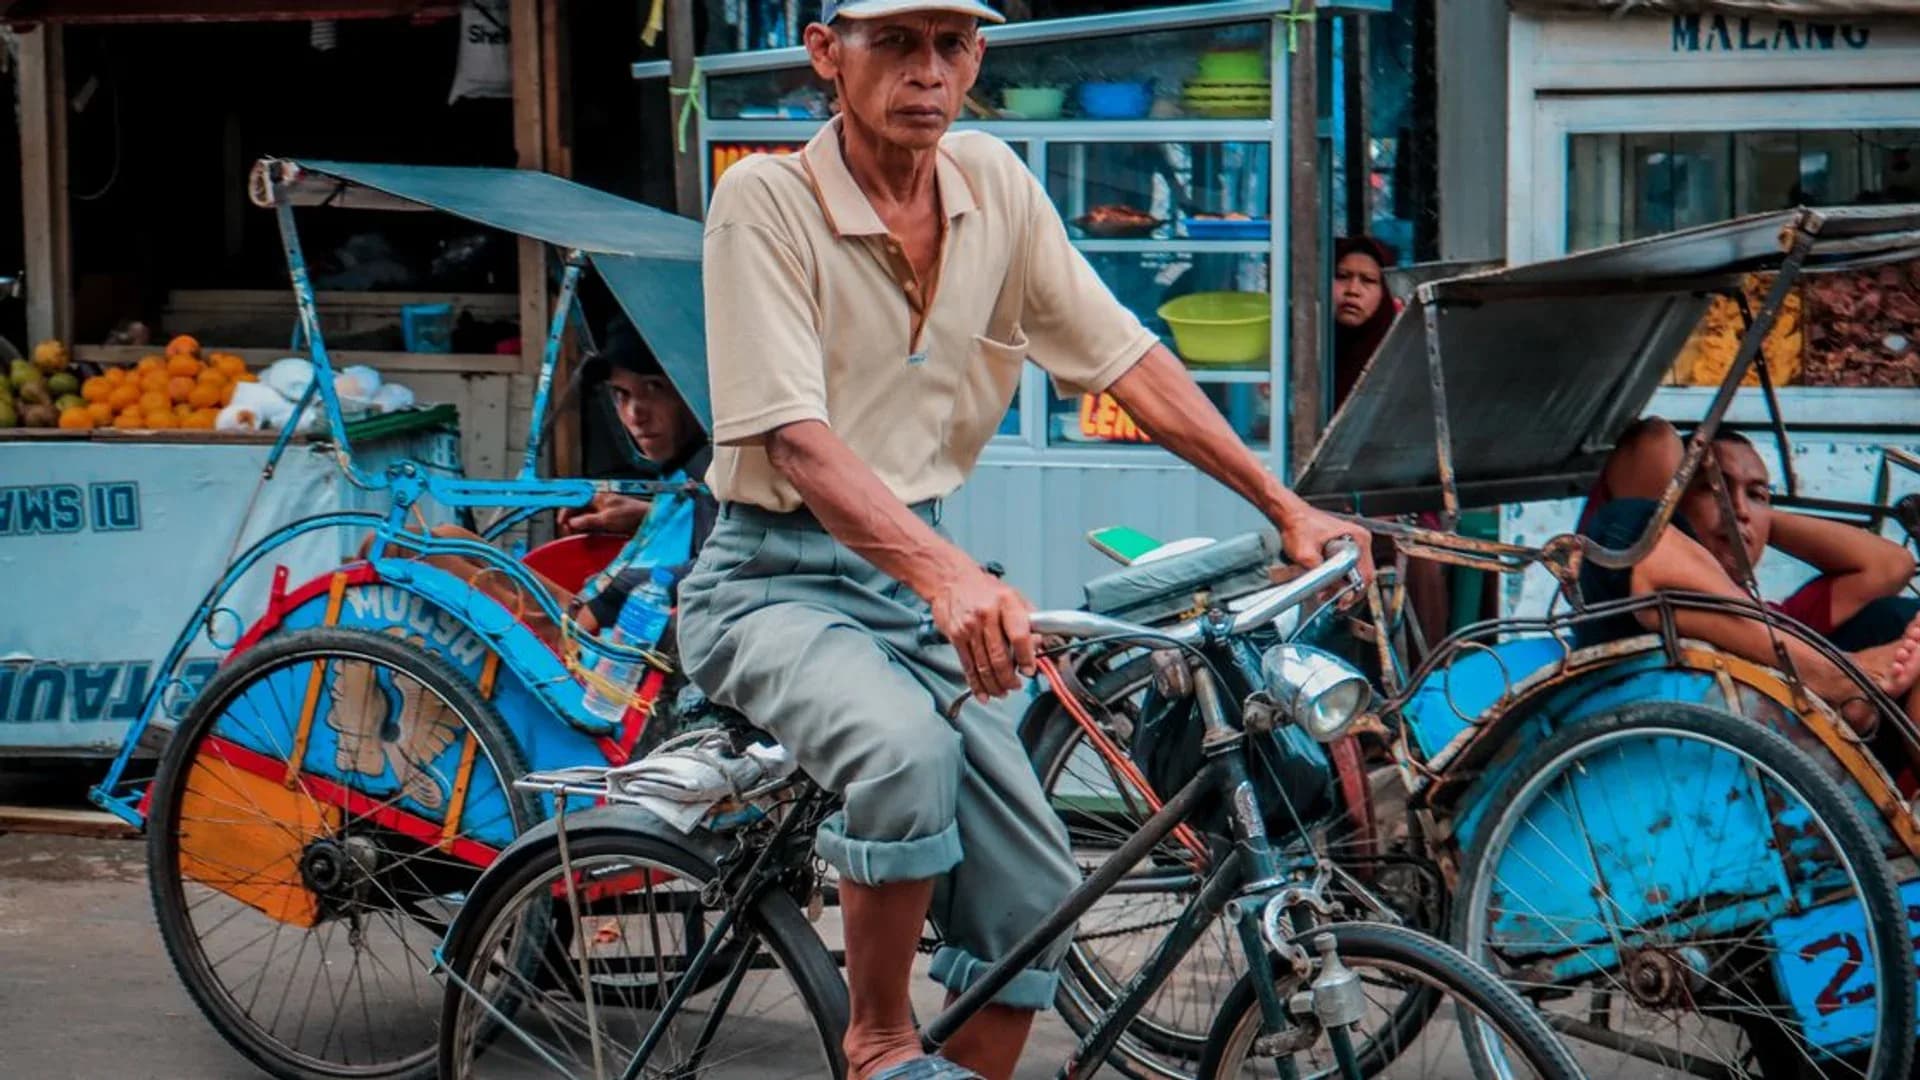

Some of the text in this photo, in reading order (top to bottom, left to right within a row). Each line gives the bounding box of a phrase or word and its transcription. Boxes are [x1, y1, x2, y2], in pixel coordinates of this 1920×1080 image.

[1672, 15, 1870, 51] MALANG
[91, 483, 139, 530] DI
[1799, 932, 1875, 1016] 2
